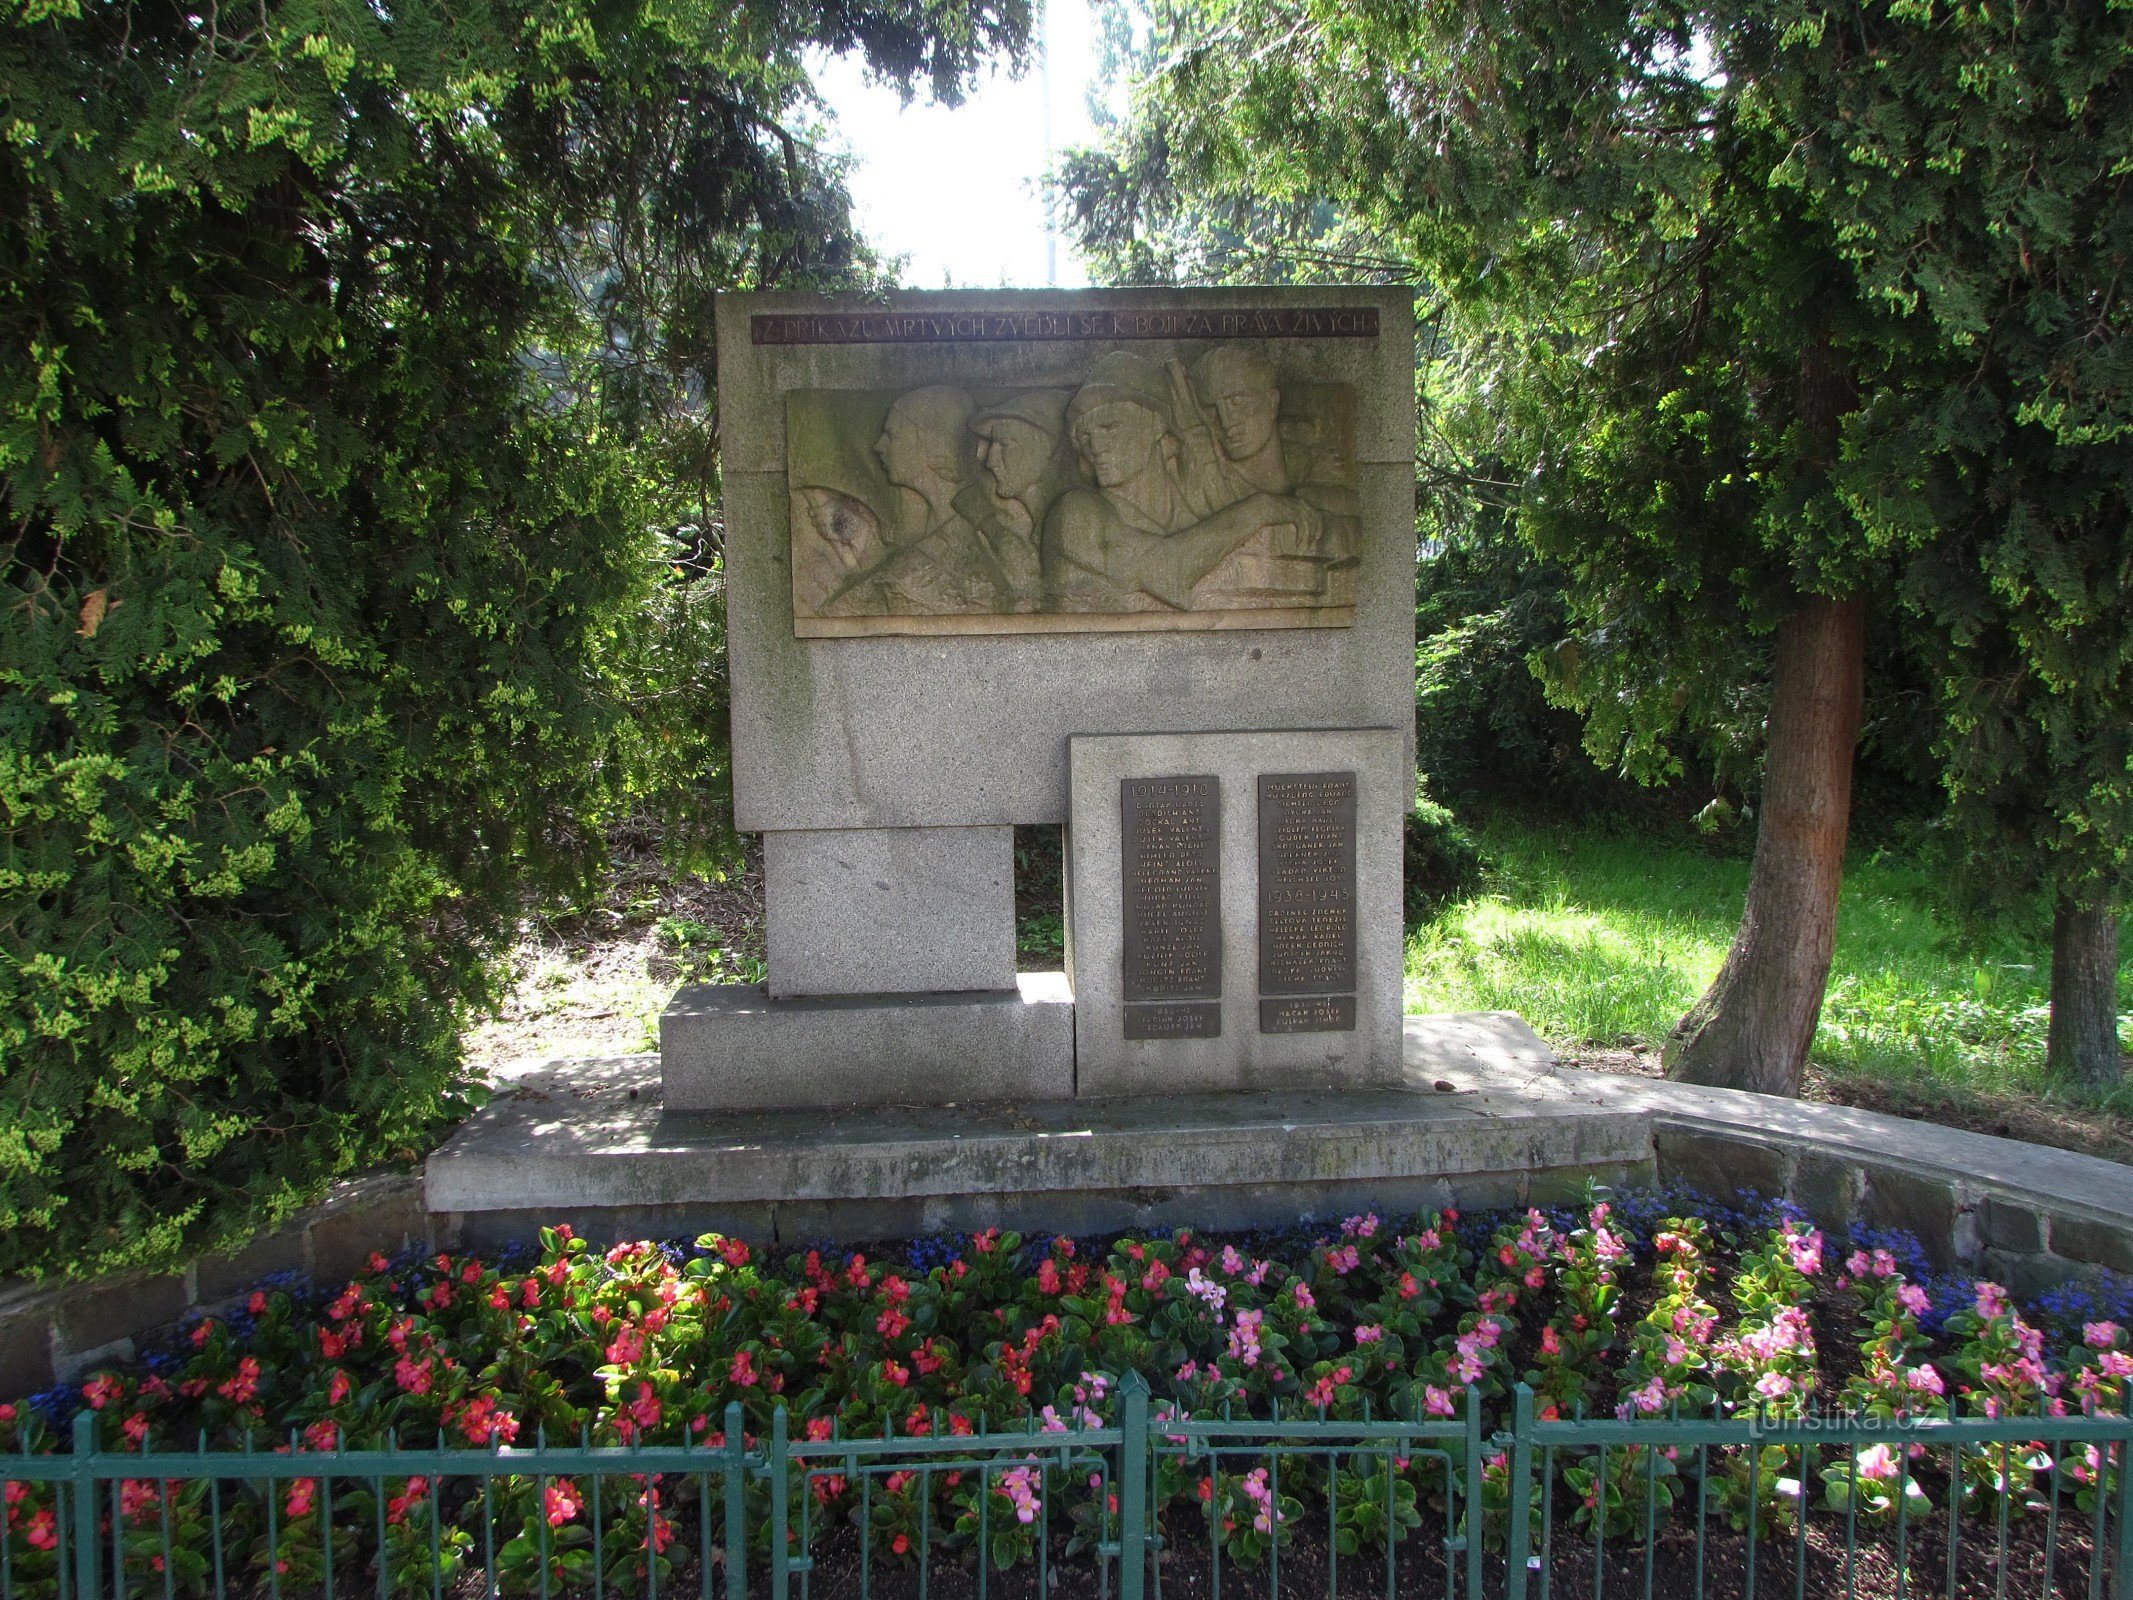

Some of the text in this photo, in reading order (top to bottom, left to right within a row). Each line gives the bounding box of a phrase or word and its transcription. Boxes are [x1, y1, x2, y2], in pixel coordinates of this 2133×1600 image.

[763, 320, 774, 339] Z
[995, 317, 1071, 335] ZVEDLI
[1080, 316, 1104, 335] SE
[1113, 315, 1125, 334] K
[1135, 316, 1177, 334] BOJI
[1186, 315, 1212, 334] ZA
[1222, 311, 1283, 333] PRÁVA
[1131, 783, 1208, 797] 1914-1918
[1268, 888, 1349, 903] 1938-1945
